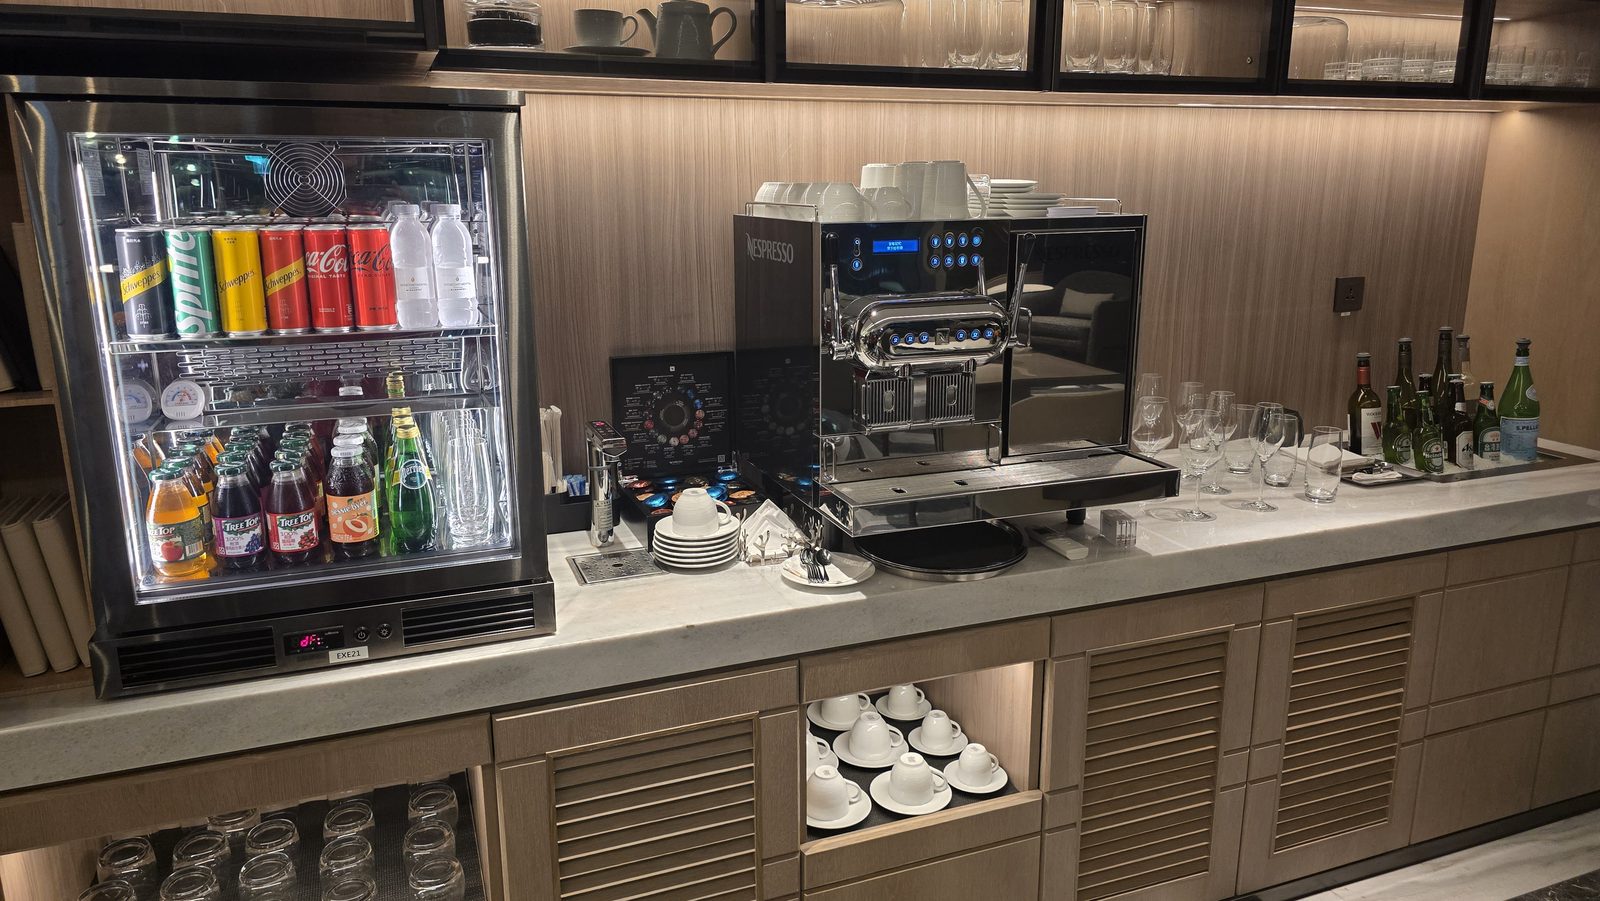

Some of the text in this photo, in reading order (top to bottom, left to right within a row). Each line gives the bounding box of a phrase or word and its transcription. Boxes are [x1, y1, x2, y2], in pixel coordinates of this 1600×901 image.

[745, 232, 794, 264] NESPRESSO
[122, 271, 162, 295] Schweppes
[219, 269, 255, 293] Schweppes
[264, 268, 301, 291] Schweppes
[224, 517, 259, 531] TREE TOP
[280, 512, 313, 527] TREE TOP
[158, 527, 175, 535] TOP
[336, 650, 361, 660] EXE21
